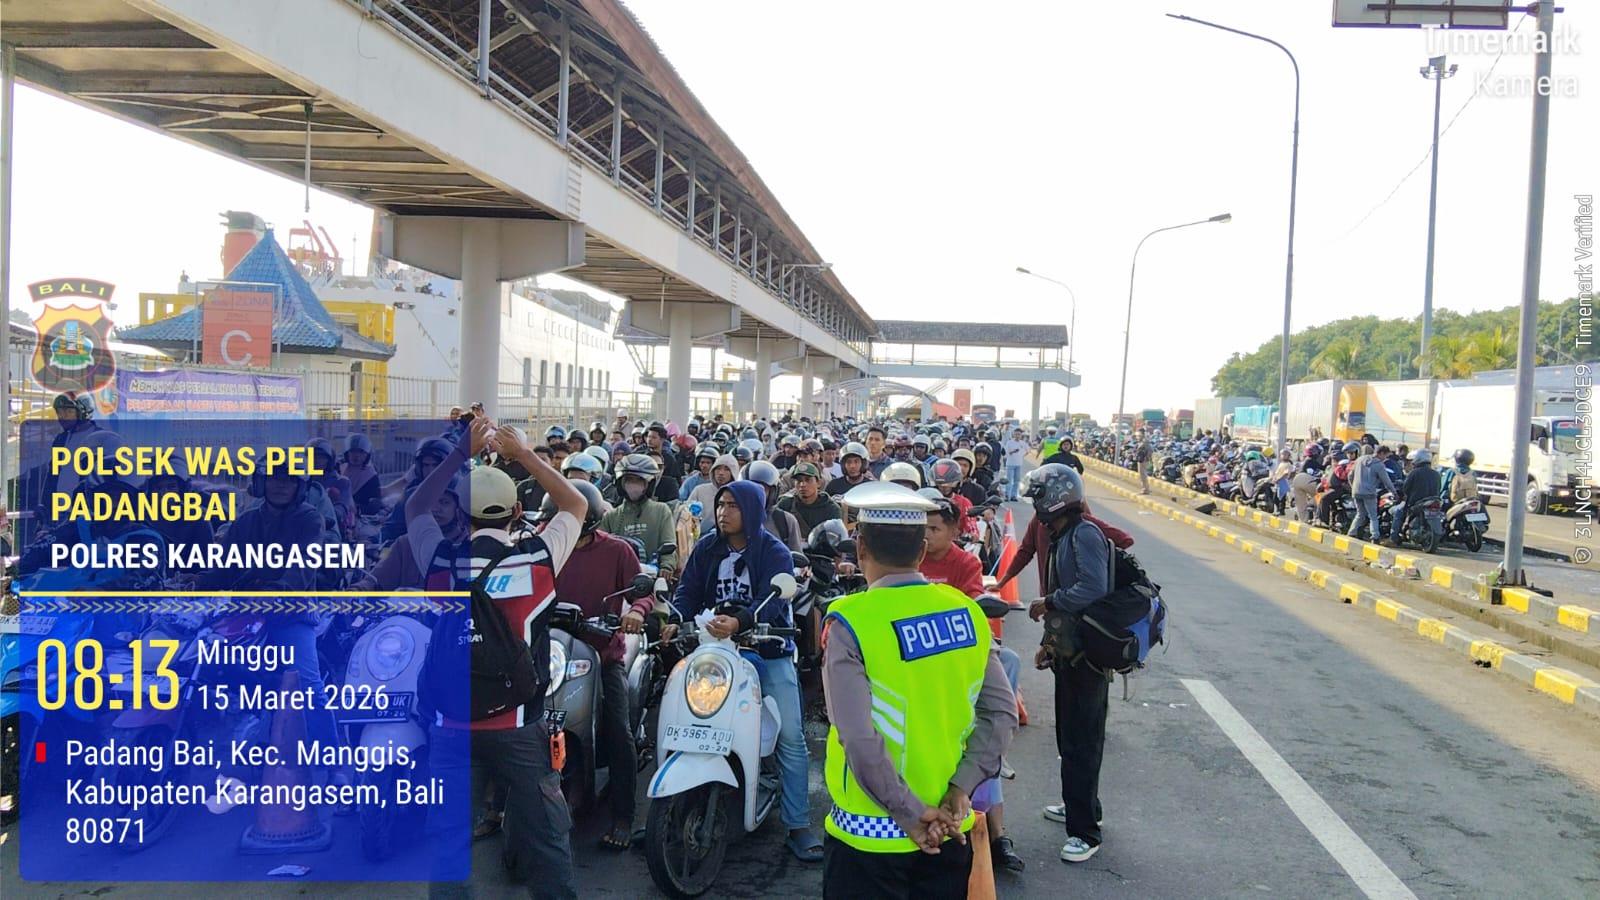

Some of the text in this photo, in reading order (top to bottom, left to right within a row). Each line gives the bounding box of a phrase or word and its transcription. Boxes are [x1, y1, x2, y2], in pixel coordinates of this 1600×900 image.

[220, 329, 253, 367] C
[901, 613, 974, 654] POLISI
[666, 726, 681, 737] DK
[681, 728, 709, 740] 5965
